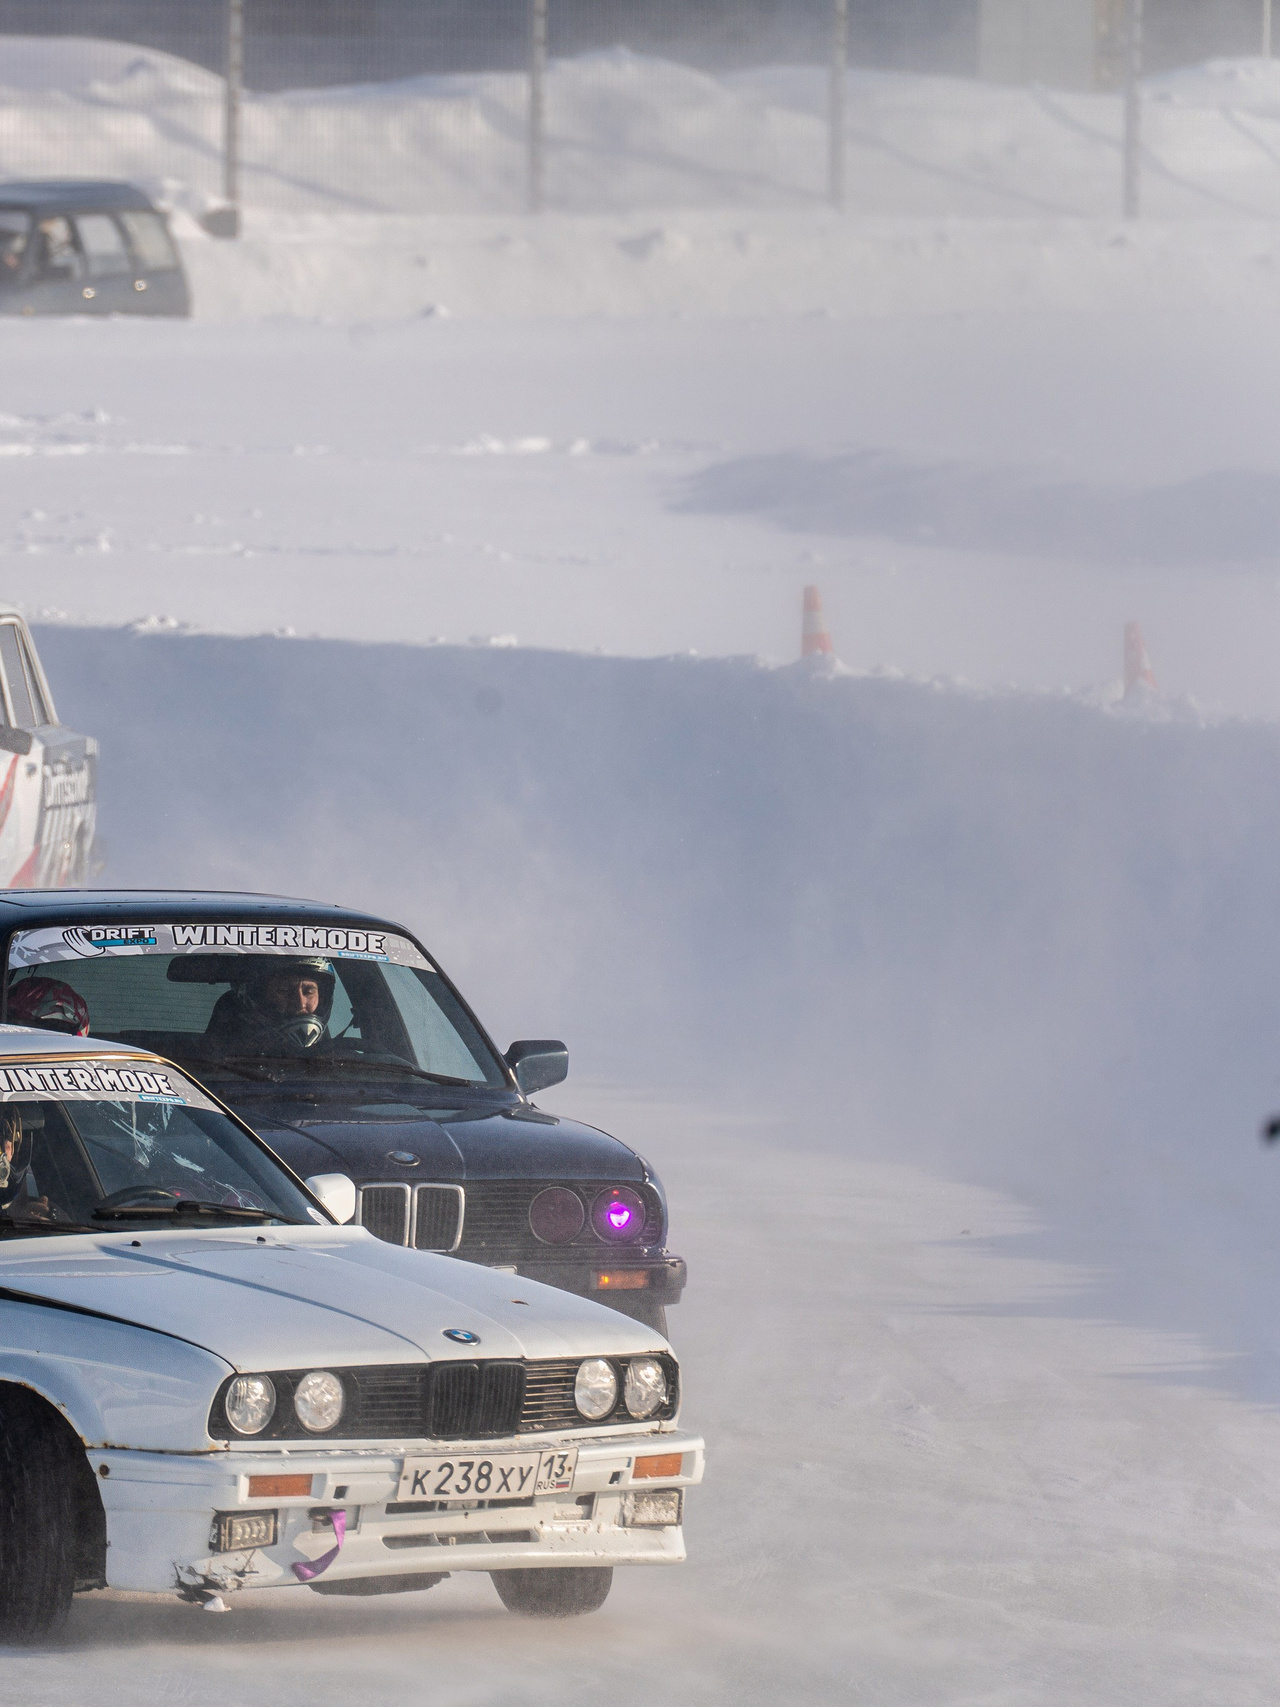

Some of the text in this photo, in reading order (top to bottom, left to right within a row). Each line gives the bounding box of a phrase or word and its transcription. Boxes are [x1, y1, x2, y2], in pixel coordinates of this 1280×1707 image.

[92, 925, 388, 955] DRIFT WINTER MODE
[97, 1069, 179, 1097] MODE
[411, 1459, 534, 1496] К238ХУ
[543, 1454, 569, 1479] 13
[536, 1480, 556, 1491] RUS
